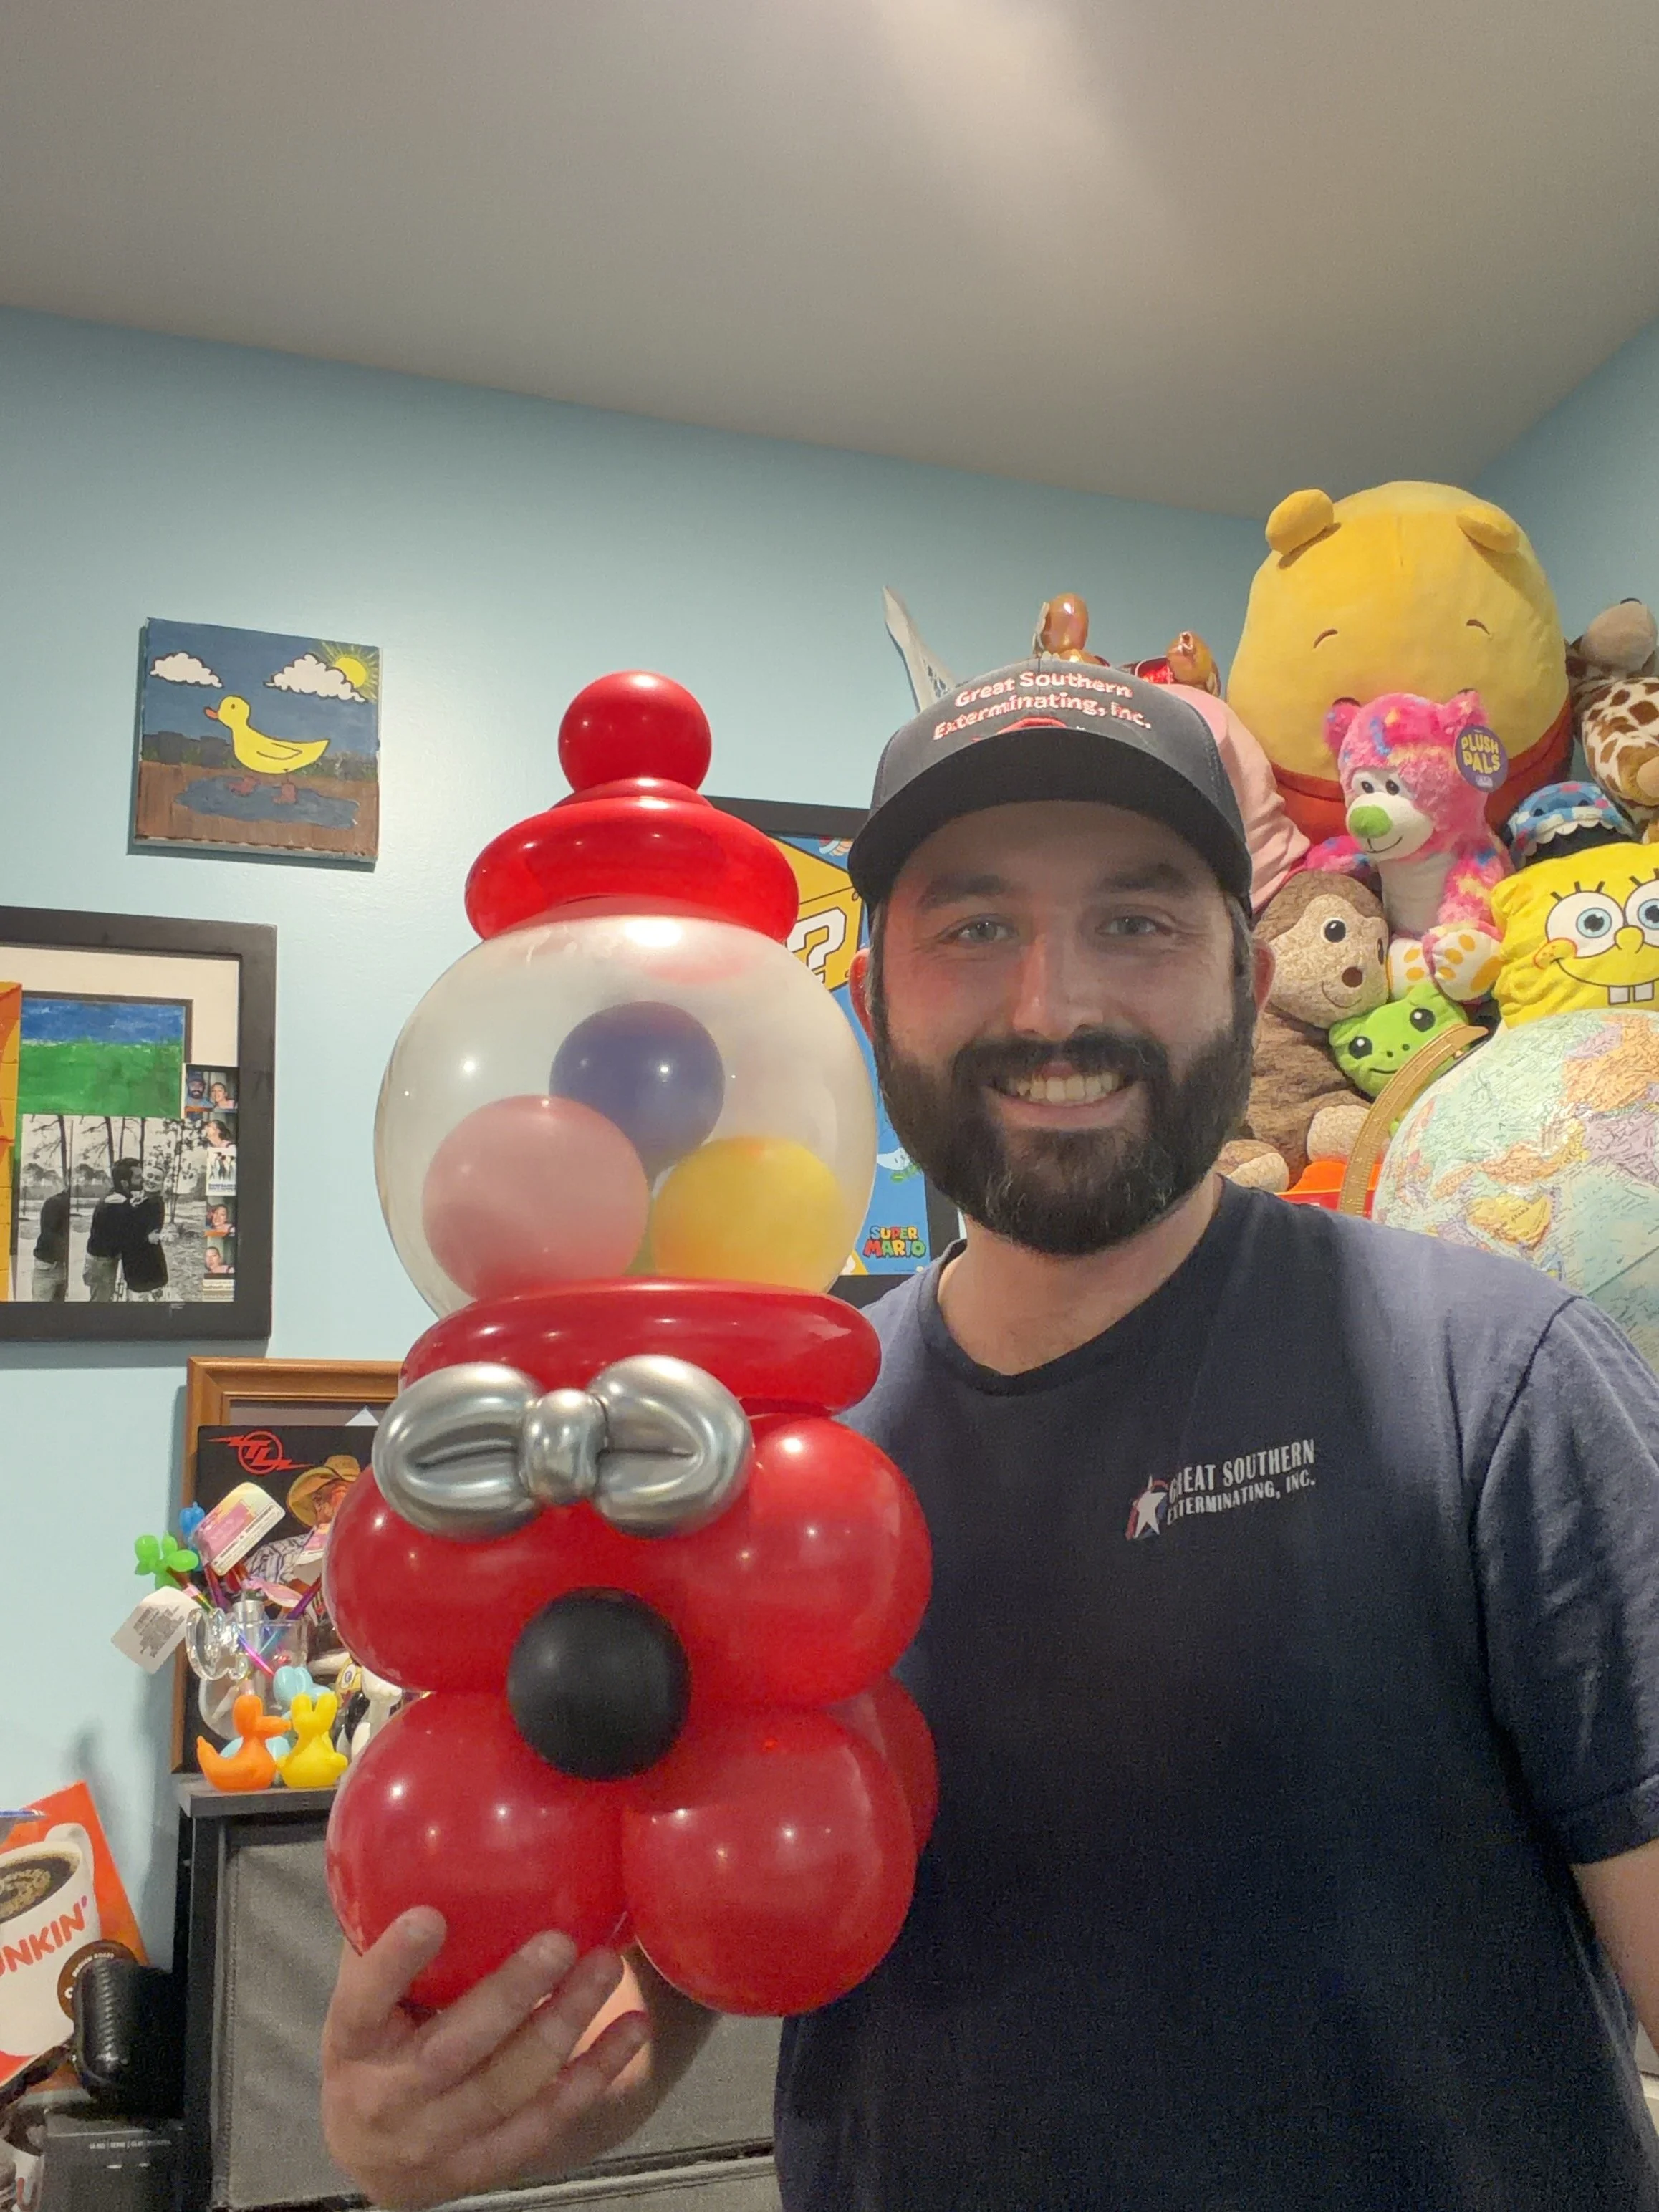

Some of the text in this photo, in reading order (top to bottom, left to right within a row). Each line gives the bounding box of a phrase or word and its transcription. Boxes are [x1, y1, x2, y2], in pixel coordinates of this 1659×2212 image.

[954, 670, 1133, 708] Great Southern
[932, 692, 1152, 741] Exterminating, Inc.
[1461, 734, 1499, 754] PLUSH
[1462, 751, 1501, 774] PALS
[870, 1225, 918, 1240] SUPER
[863, 1239, 926, 1259] MARIO
[1223, 1438, 1315, 1488] SOUTHERN
[1286, 1469, 1317, 1494] INC.
